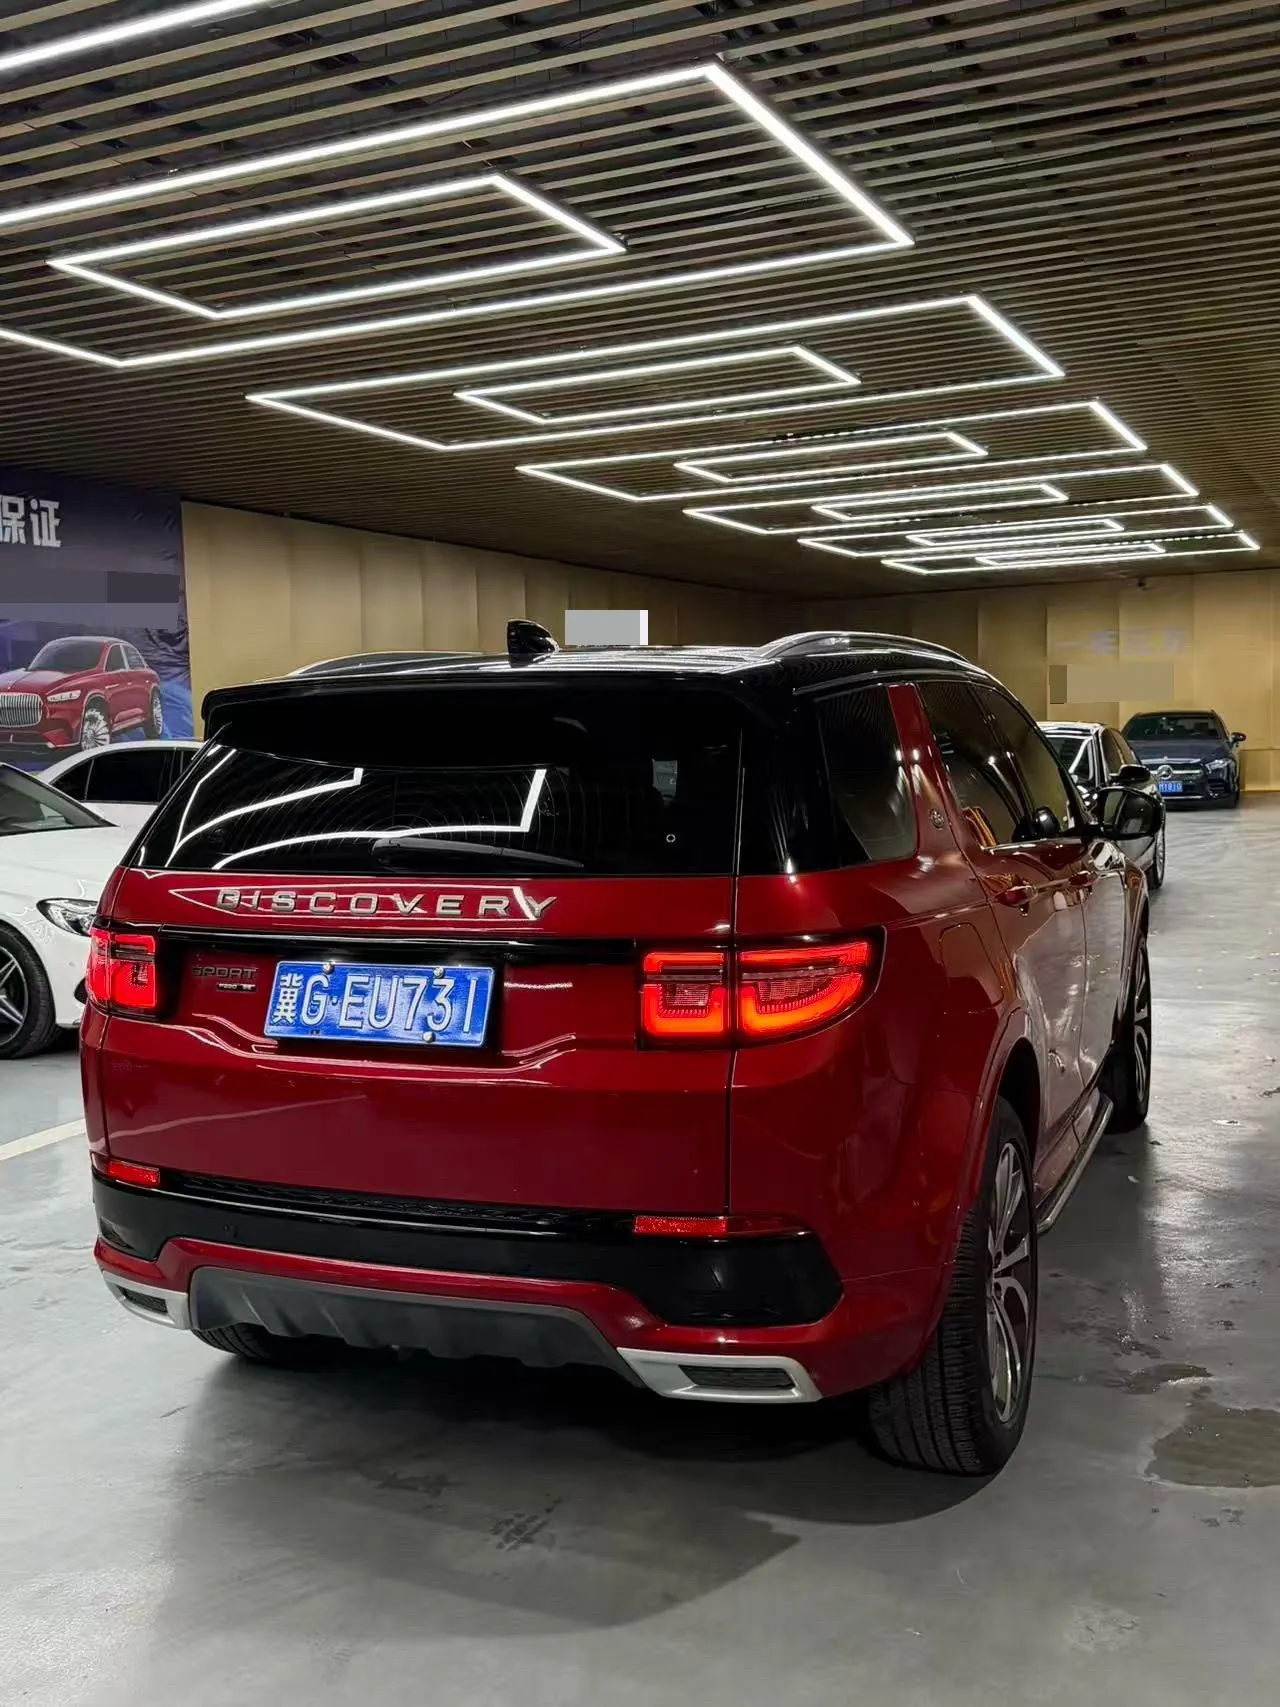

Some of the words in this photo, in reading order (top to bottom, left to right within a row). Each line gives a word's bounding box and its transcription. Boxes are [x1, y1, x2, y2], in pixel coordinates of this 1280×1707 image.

[0, 495, 62, 548] 保证
[216, 889, 558, 917] DISCOVERY
[192, 966, 257, 979] SPORT
